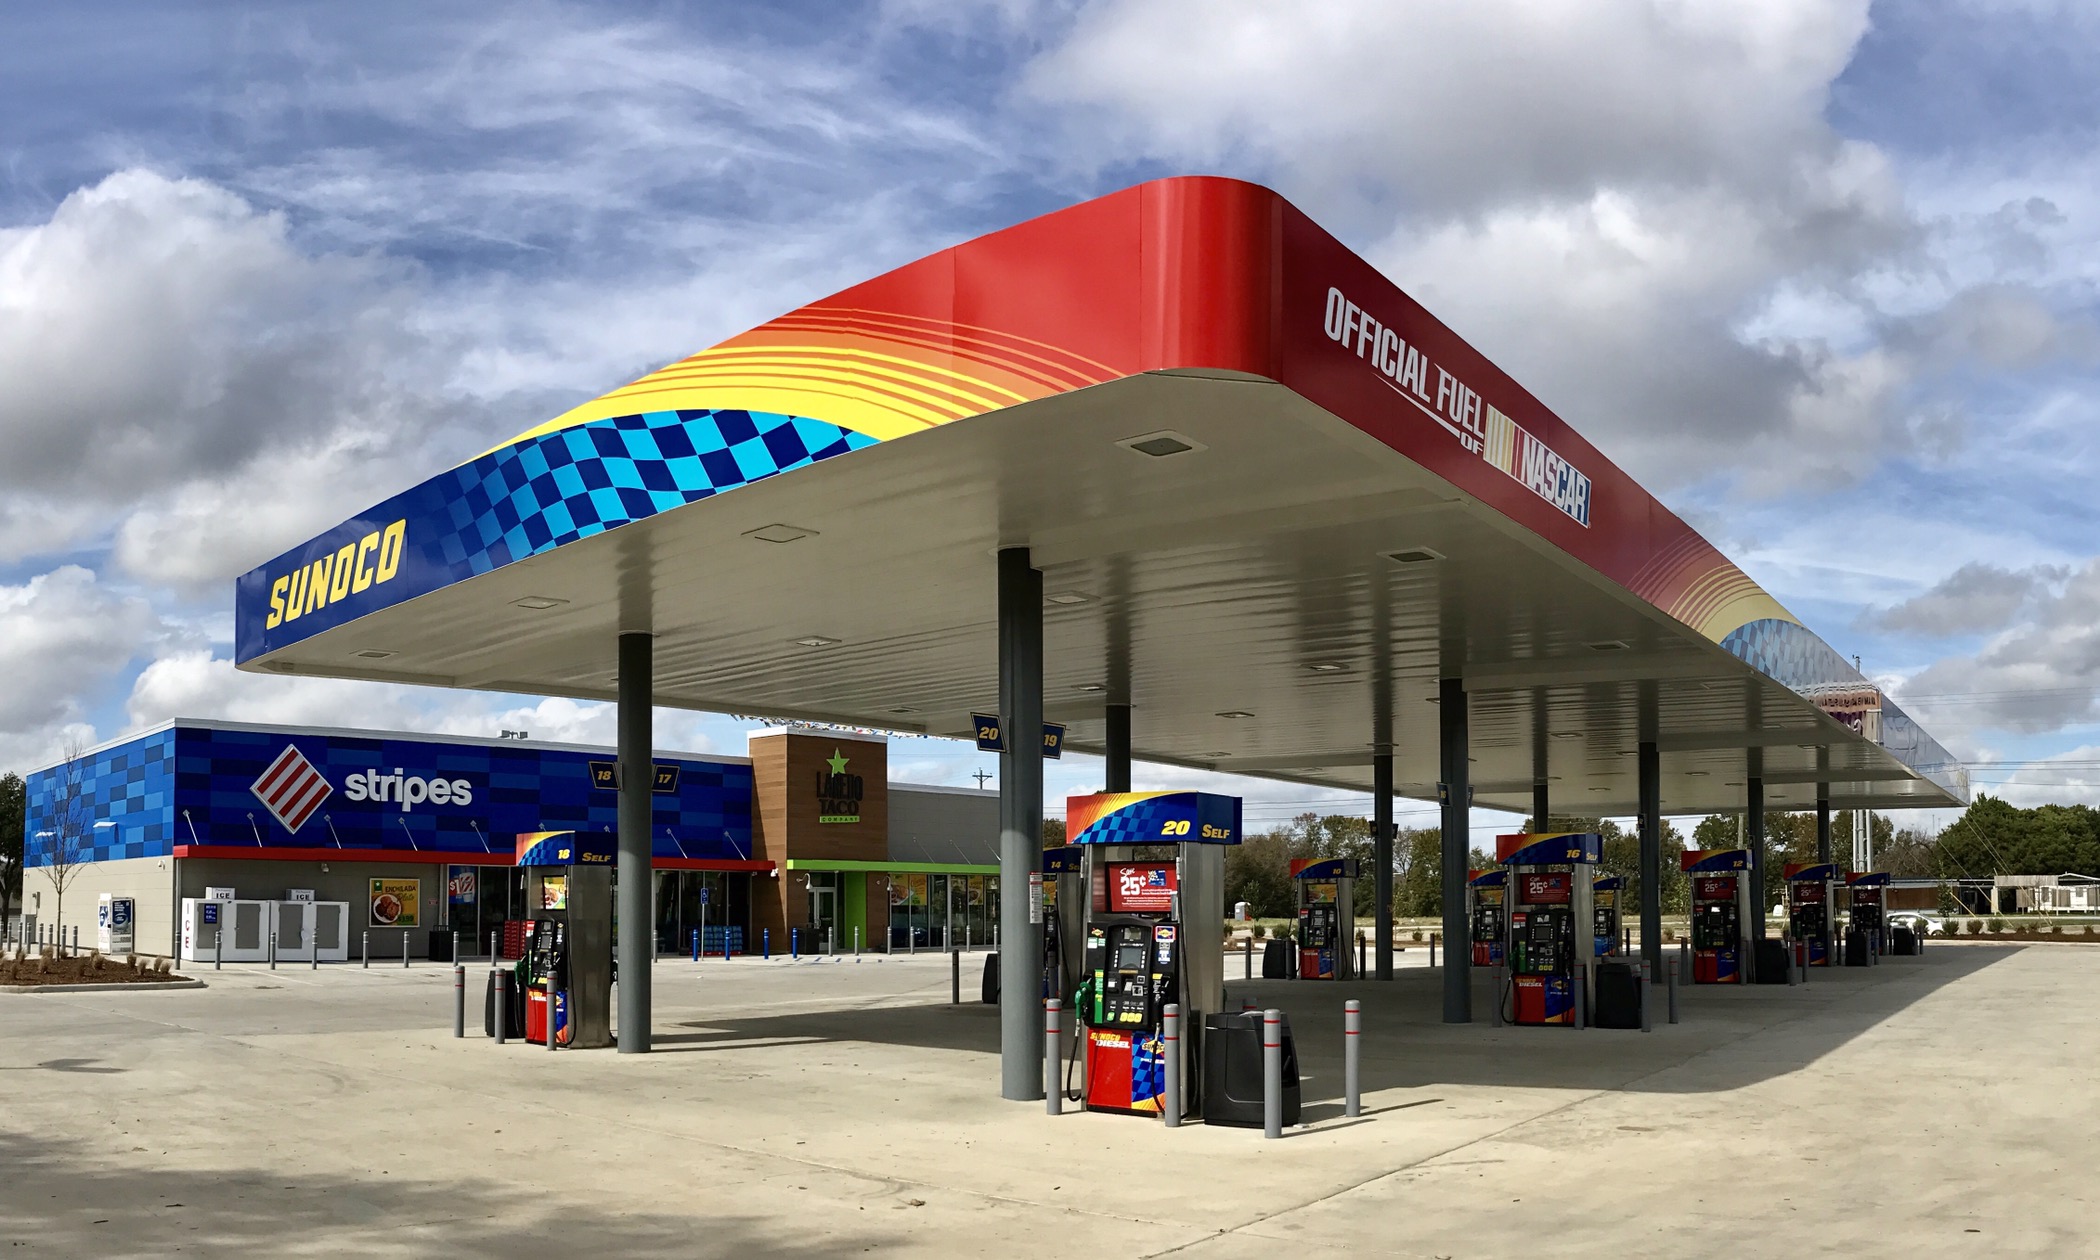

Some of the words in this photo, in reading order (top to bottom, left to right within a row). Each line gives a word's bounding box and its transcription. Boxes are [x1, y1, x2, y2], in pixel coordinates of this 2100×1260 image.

[1324, 287, 1431, 403] OFFICIAL
[1434, 363, 1484, 439] FUEL
[1460, 432, 1484, 455] OF
[1521, 434, 1588, 523] NASCAR
[266, 519, 406, 630] SUNOCO
[979, 726, 999, 740] 20
[1044, 734, 1058, 747] 19
[597, 770, 612, 781] 18
[658, 774, 672, 784] 17
[344, 767, 472, 812] stripes
[816, 771, 864, 801] LAREDO
[818, 799, 860, 815] TACO
[1161, 820, 1191, 836] 20
[558, 849, 571, 860] 18
[1566, 849, 1581, 859] 16
[1051, 861, 1062, 869] 14
[1733, 860, 1744, 868] 12
[296, 893, 310, 901] ICE
[1090, 1032, 1121, 1042] SUNOCO
[1095, 1040, 1131, 1049] DIESEL
